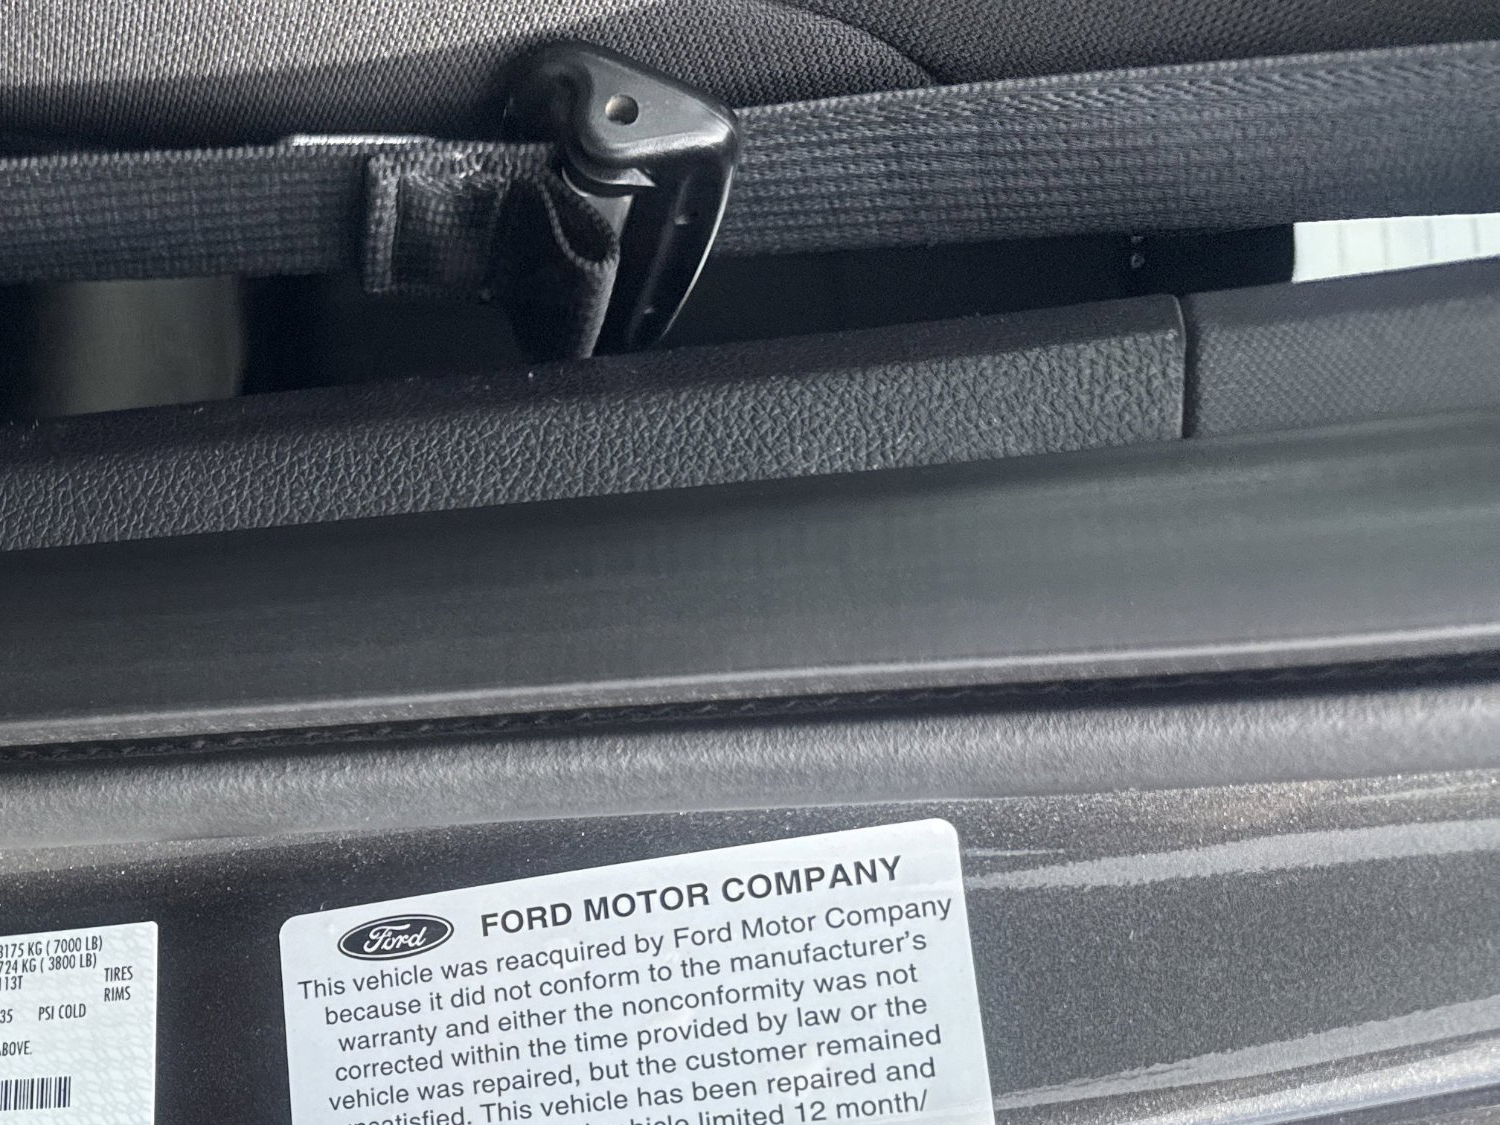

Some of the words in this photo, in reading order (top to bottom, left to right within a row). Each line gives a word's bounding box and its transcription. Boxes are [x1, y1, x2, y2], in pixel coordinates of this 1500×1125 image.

[481, 902, 572, 936] FORD
[583, 882, 709, 921] MOTOR
[721, 855, 900, 902] COMPANY
[21, 957, 36, 973] KG
[27, 940, 42, 956] KG
[297, 977, 345, 999] This
[352, 964, 432, 991] vehicle
[440, 959, 487, 979] was
[496, 935, 626, 972] reacquired
[634, 933, 663, 957] by
[673, 921, 731, 948] Ford
[741, 915, 816, 939] Motor
[824, 897, 951, 928] Company
[324, 998, 421, 1025] because
[429, 991, 443, 1010] it
[450, 984, 485, 1008] did
[493, 980, 532, 1002] not
[539, 969, 639, 996] conform
[647, 963, 672, 982] to
[679, 957, 720, 978] the
[730, 930, 926, 972] manufacturer's
[362, 923, 428, 953] Ford
[335, 1049, 443, 1081] corrected
[450, 1041, 520, 1066] within
[527, 1037, 566, 1057] the
[573, 1031, 627, 1052] time
[636, 1012, 747, 1051] provided
[756, 1011, 787, 1035] by
[796, 1006, 840, 1027] law
[850, 1003, 876, 1021] or
[884, 995, 926, 1017] the
[337, 1024, 437, 1051] warranty
[445, 1014, 489, 1038] and
[497, 1008, 566, 1031] either
[573, 1001, 612, 1022] the
[622, 977, 804, 1016] nonconformity
[812, 973, 866, 993] was
[875, 963, 918, 986] not
[328, 1084, 409, 1110] vehicle
[416, 1081, 464, 1100] was
[472, 1063, 580, 1097] repaired,
[588, 1059, 629, 1081] but
[635, 1055, 676, 1076] the
[685, 1042, 807, 1070] customer
[816, 1023, 941, 1056] remained
[479, 1100, 532, 1122] This
[539, 1090, 627, 1116] vehicle
[636, 1086, 683, 1107] has
[691, 1080, 756, 1101] been
[766, 1062, 876, 1095] repaired
[886, 1056, 935, 1081] and
[794, 1100, 826, 1122] 12
[835, 1088, 927, 1118] month/
